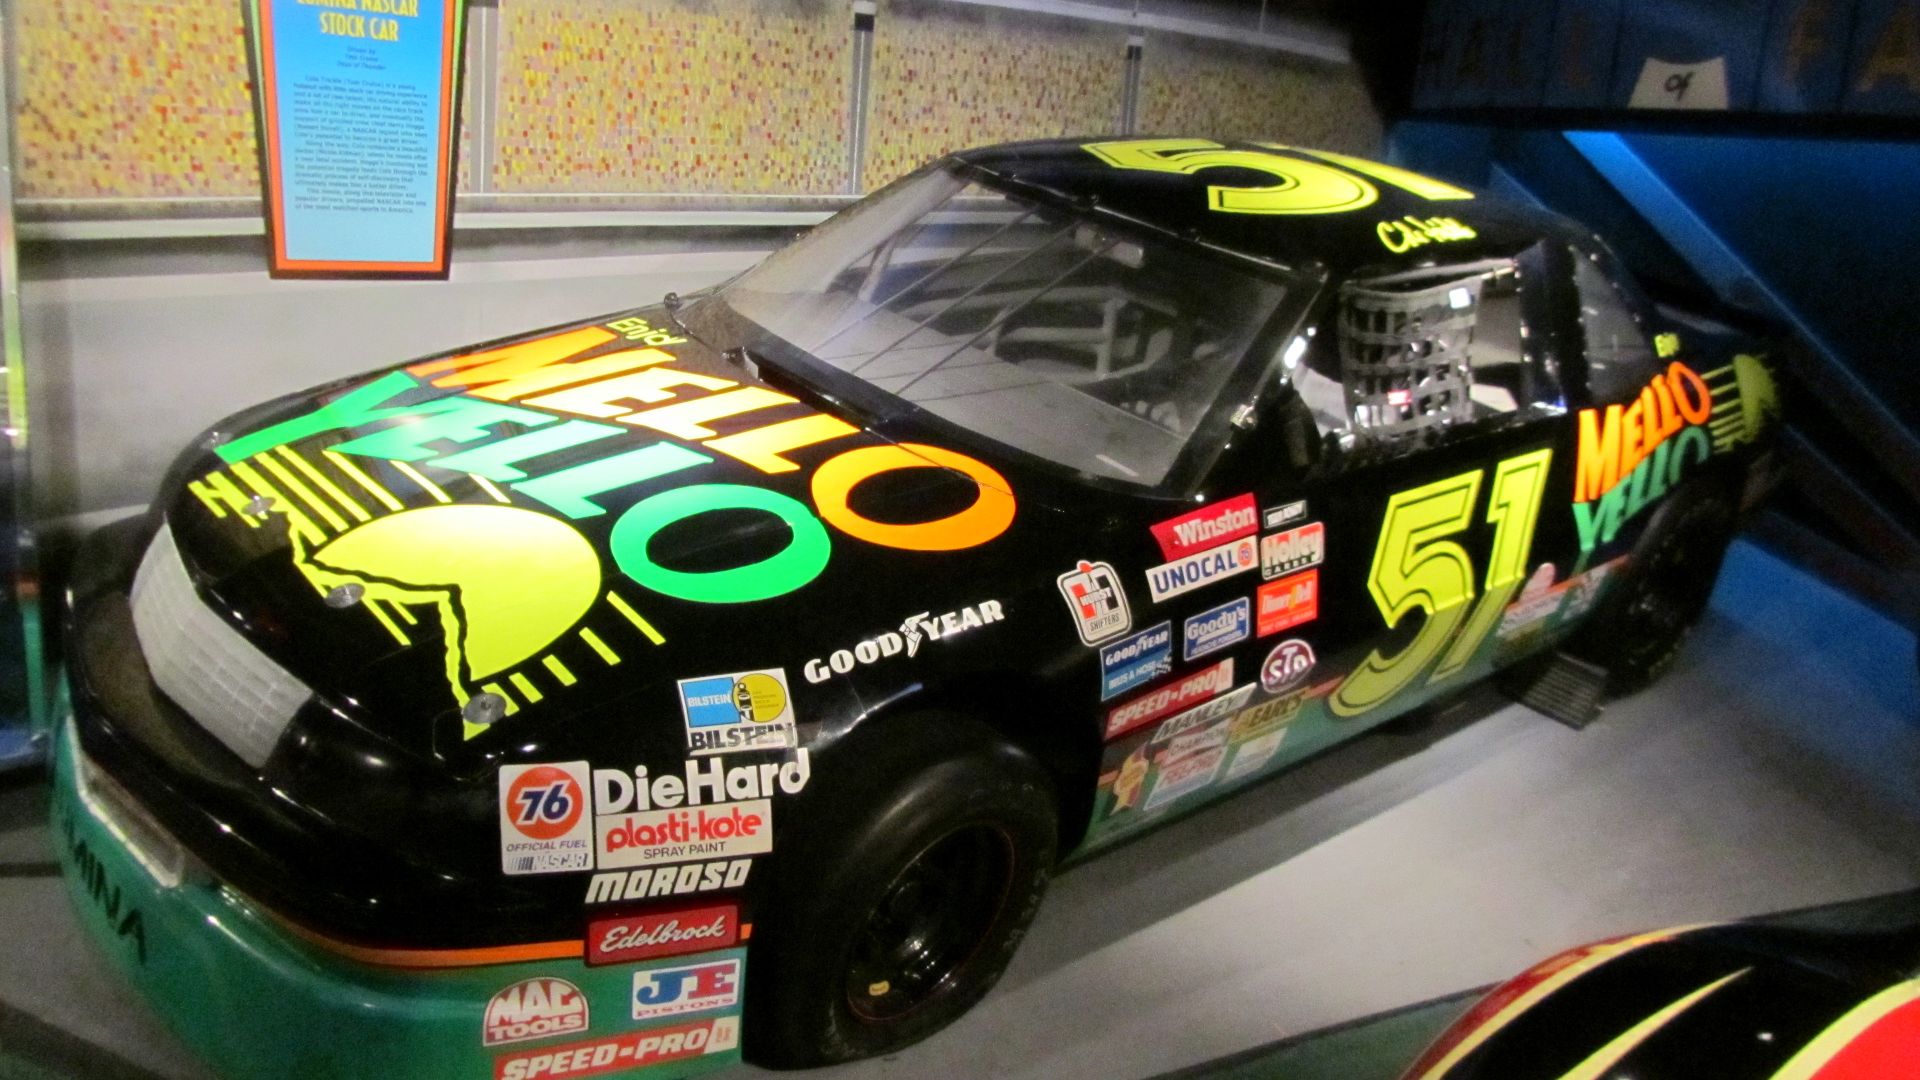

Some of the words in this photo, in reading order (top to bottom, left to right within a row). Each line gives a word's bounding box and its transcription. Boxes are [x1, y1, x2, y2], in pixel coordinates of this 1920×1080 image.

[320, 12, 365, 38] STOCK
[370, 17, 399, 41] CAR
[1080, 138, 1475, 215] 51
[407, 326, 1017, 551] MELLO
[1574, 360, 1712, 503] MELLO
[214, 371, 832, 604] YELLO
[1173, 505, 1256, 547] Winston
[1262, 529, 1321, 568] Holley
[1154, 551, 1238, 594] UNOCAL
[1328, 448, 1554, 717] 51
[1089, 613, 1121, 632] SHIFTERS
[1187, 605, 1247, 642] Goody's
[687, 693, 732, 707] BILSTEIN
[516, 780, 572, 825] 76
[593, 748, 811, 815] DieHard
[506, 841, 558, 852] OFFICIAL
[559, 839, 588, 849] FUEL
[606, 806, 762, 853] plasti-kote
[643, 846, 686, 860] SPRAY
[688, 840, 727, 855] PAINT
[584, 858, 752, 904] MOROSO
[599, 914, 726, 953] Edelbrock
[490, 981, 584, 1026] MAC
[636, 963, 738, 1005] JE
[488, 1013, 583, 1040] TOOLS
[637, 997, 735, 1018] PISTONS
[503, 1027, 710, 1080] SPEED-PRO
